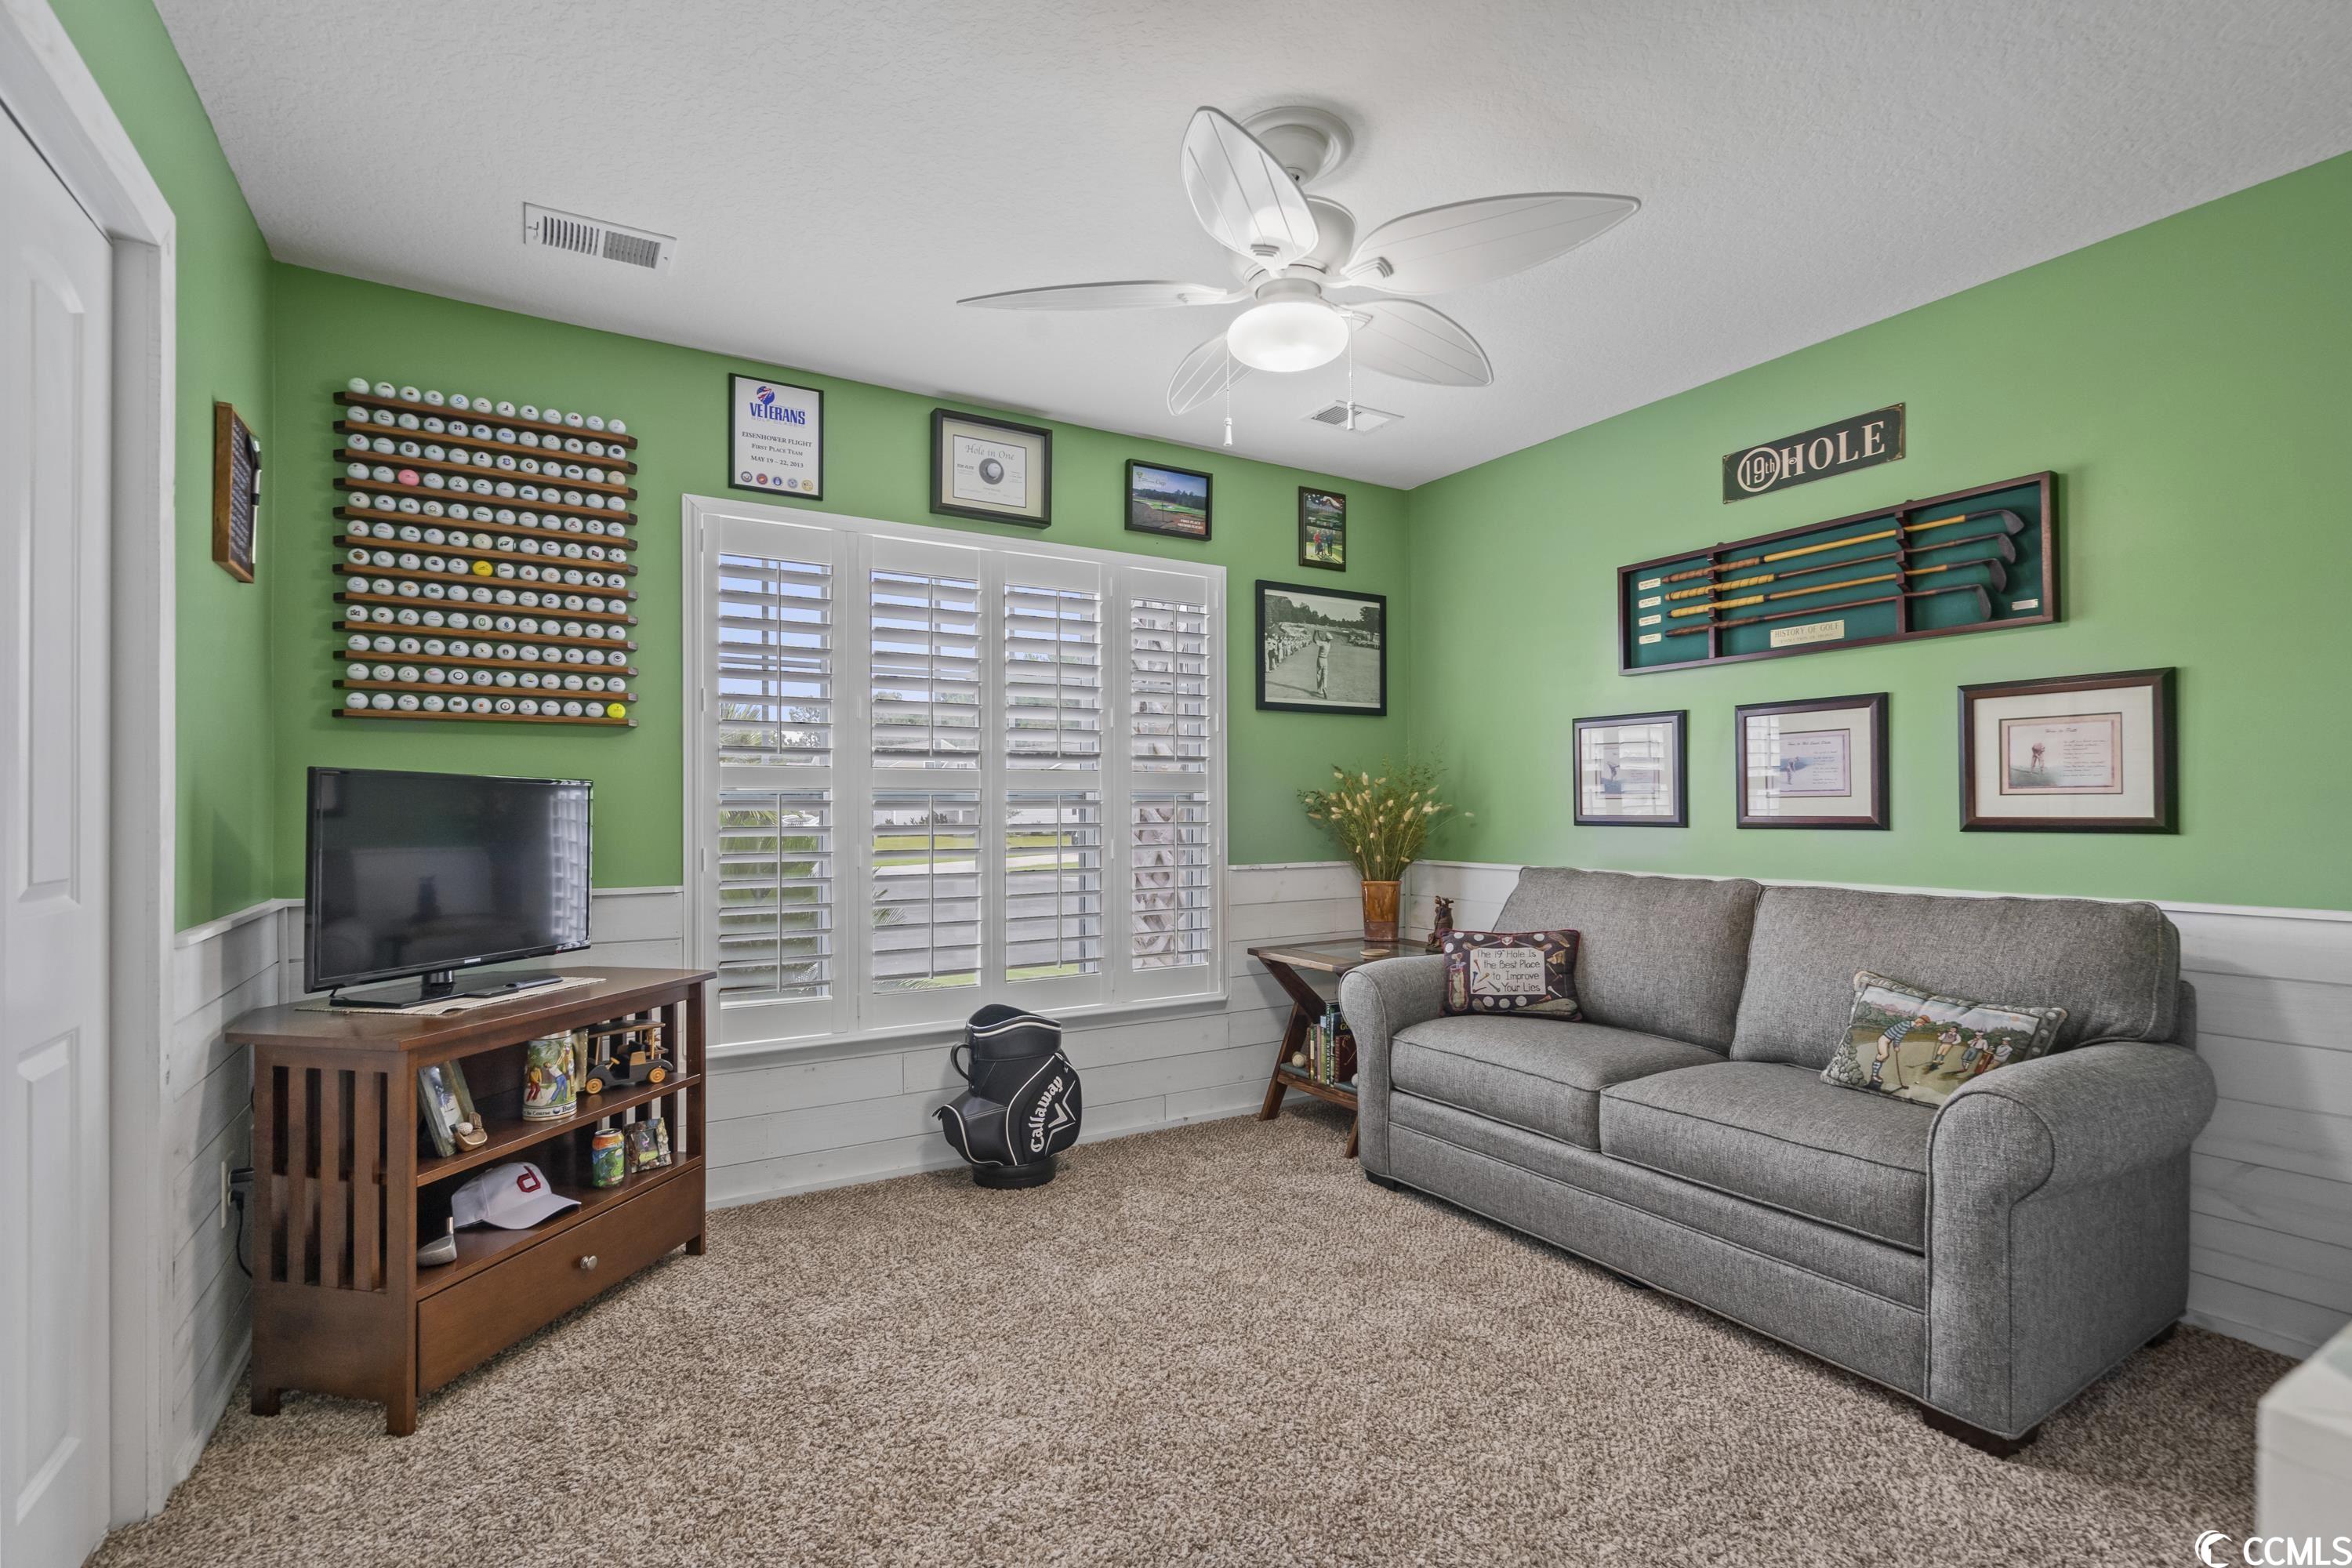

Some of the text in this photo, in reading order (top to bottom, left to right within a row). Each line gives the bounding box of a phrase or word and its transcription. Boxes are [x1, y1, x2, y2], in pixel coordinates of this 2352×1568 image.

[750, 402, 805, 425] VETERANS
[742, 431, 812, 448] EISENHOWER FLIGHT
[965, 443, 1015, 460] Hole in One
[1746, 421, 1886, 486] 19th HOLE
[1775, 626, 1806, 638] HISTORY
[1807, 625, 1818, 634] OF
[1820, 622, 1838, 632] GOLF
[1477, 949, 1491, 958] The
[1507, 949, 1526, 958] Hole
[1529, 949, 1537, 958] Is
[1484, 960, 1541, 969] the Best Place
[1506, 971, 1540, 983] Improve
[1501, 982, 1541, 992] Your Lies
[1028, 1076, 1064, 1152] Callaway
